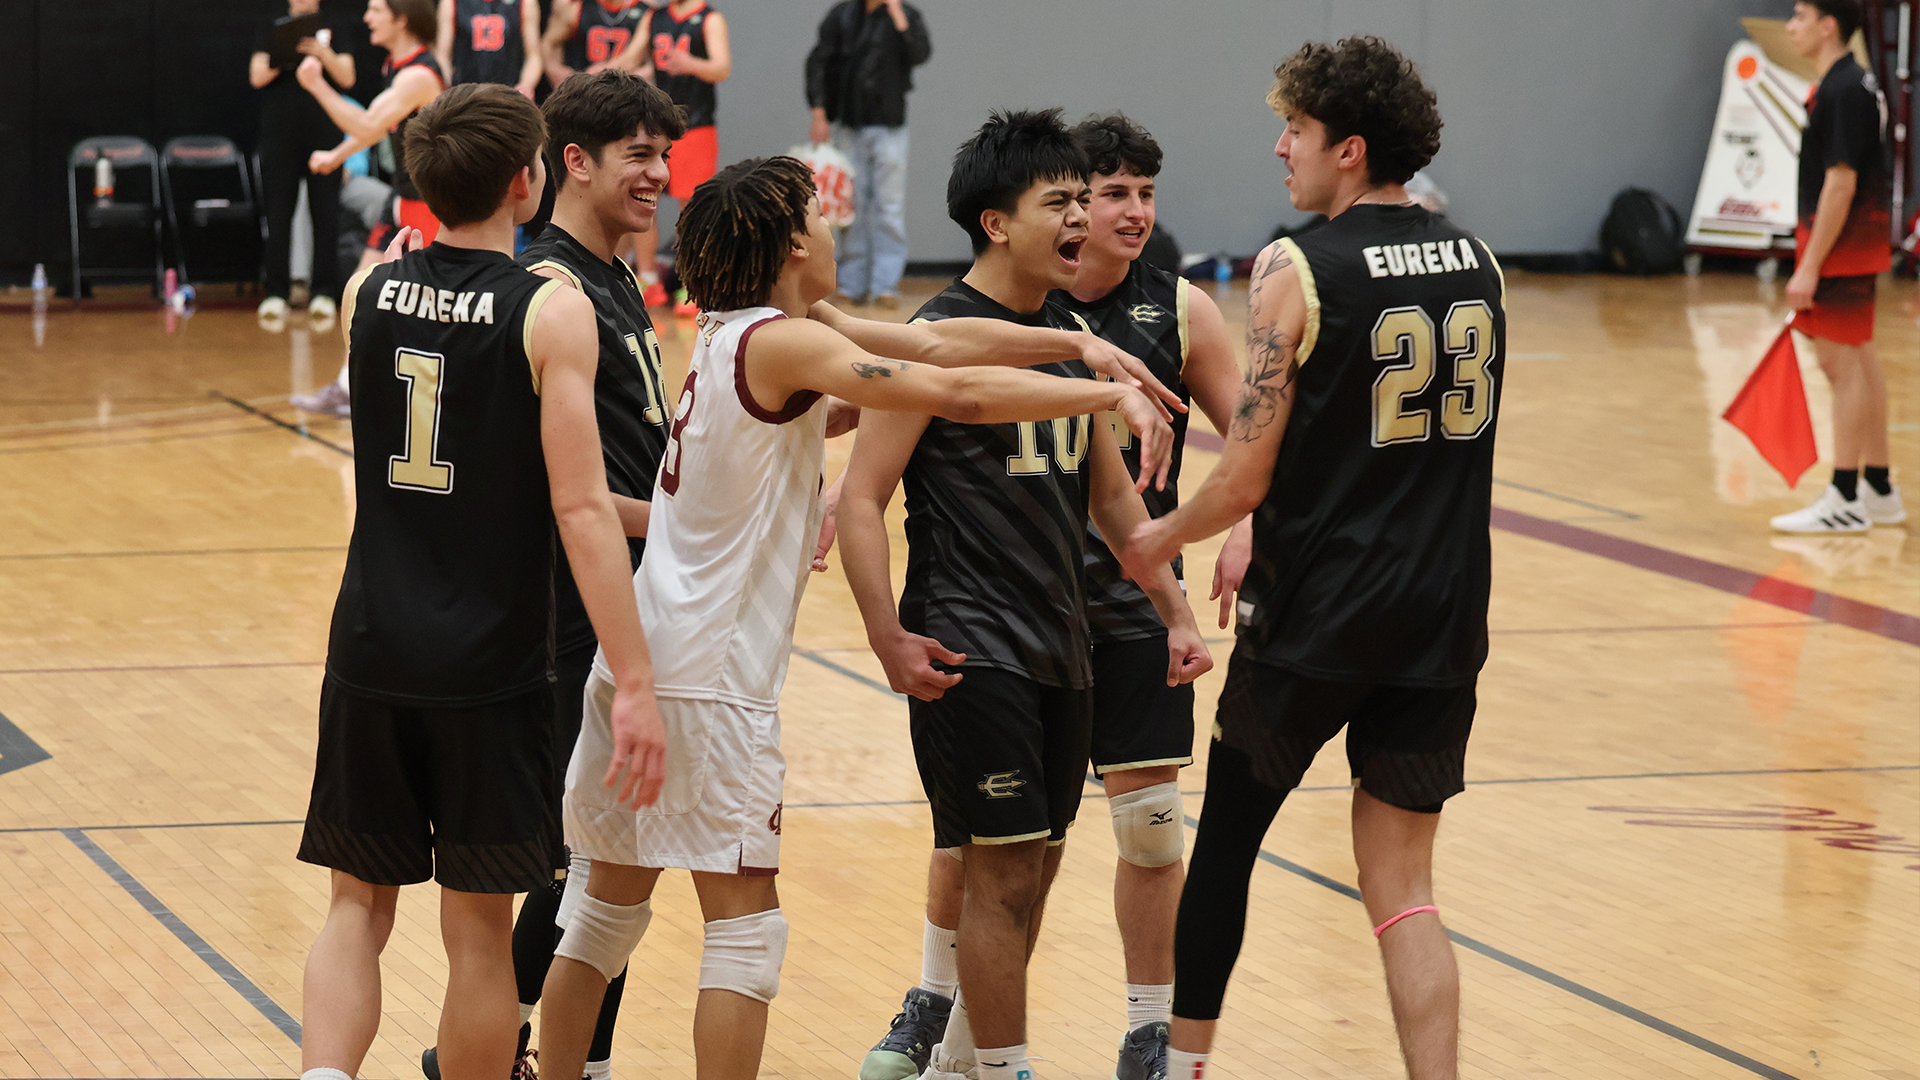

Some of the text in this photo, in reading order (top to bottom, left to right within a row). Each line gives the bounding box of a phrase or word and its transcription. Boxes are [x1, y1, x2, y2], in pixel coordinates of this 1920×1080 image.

[470, 13, 505, 51] 13
[1362, 238, 1480, 278] EUREKA
[376, 279, 495, 325] EUREKA
[1370, 299, 1497, 448] 23
[388, 347, 455, 494] 1
